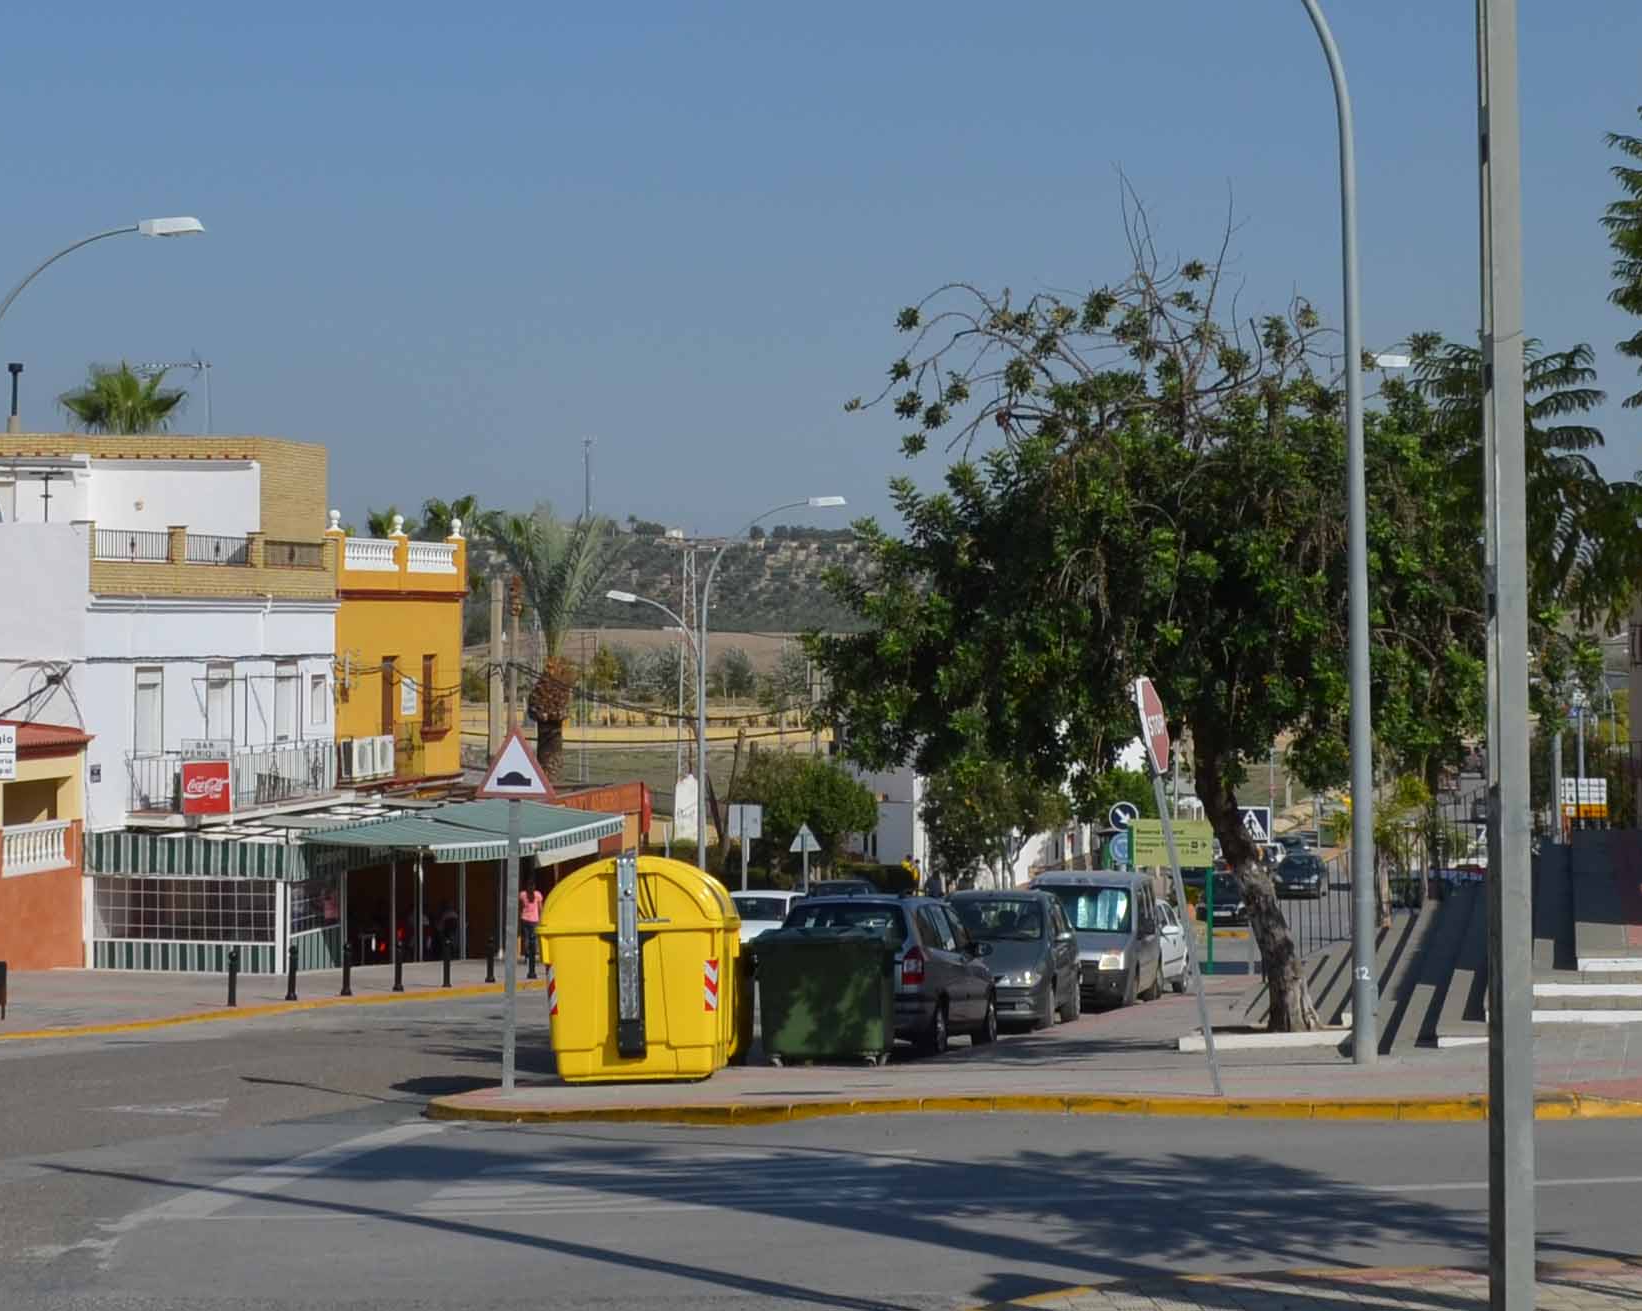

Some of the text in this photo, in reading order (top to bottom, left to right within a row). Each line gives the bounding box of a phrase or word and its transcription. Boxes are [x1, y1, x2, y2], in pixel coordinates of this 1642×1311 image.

[1147, 713, 1165, 737] STOP
[196, 742, 214, 750] BAR
[1356, 966, 1372, 980] 12
